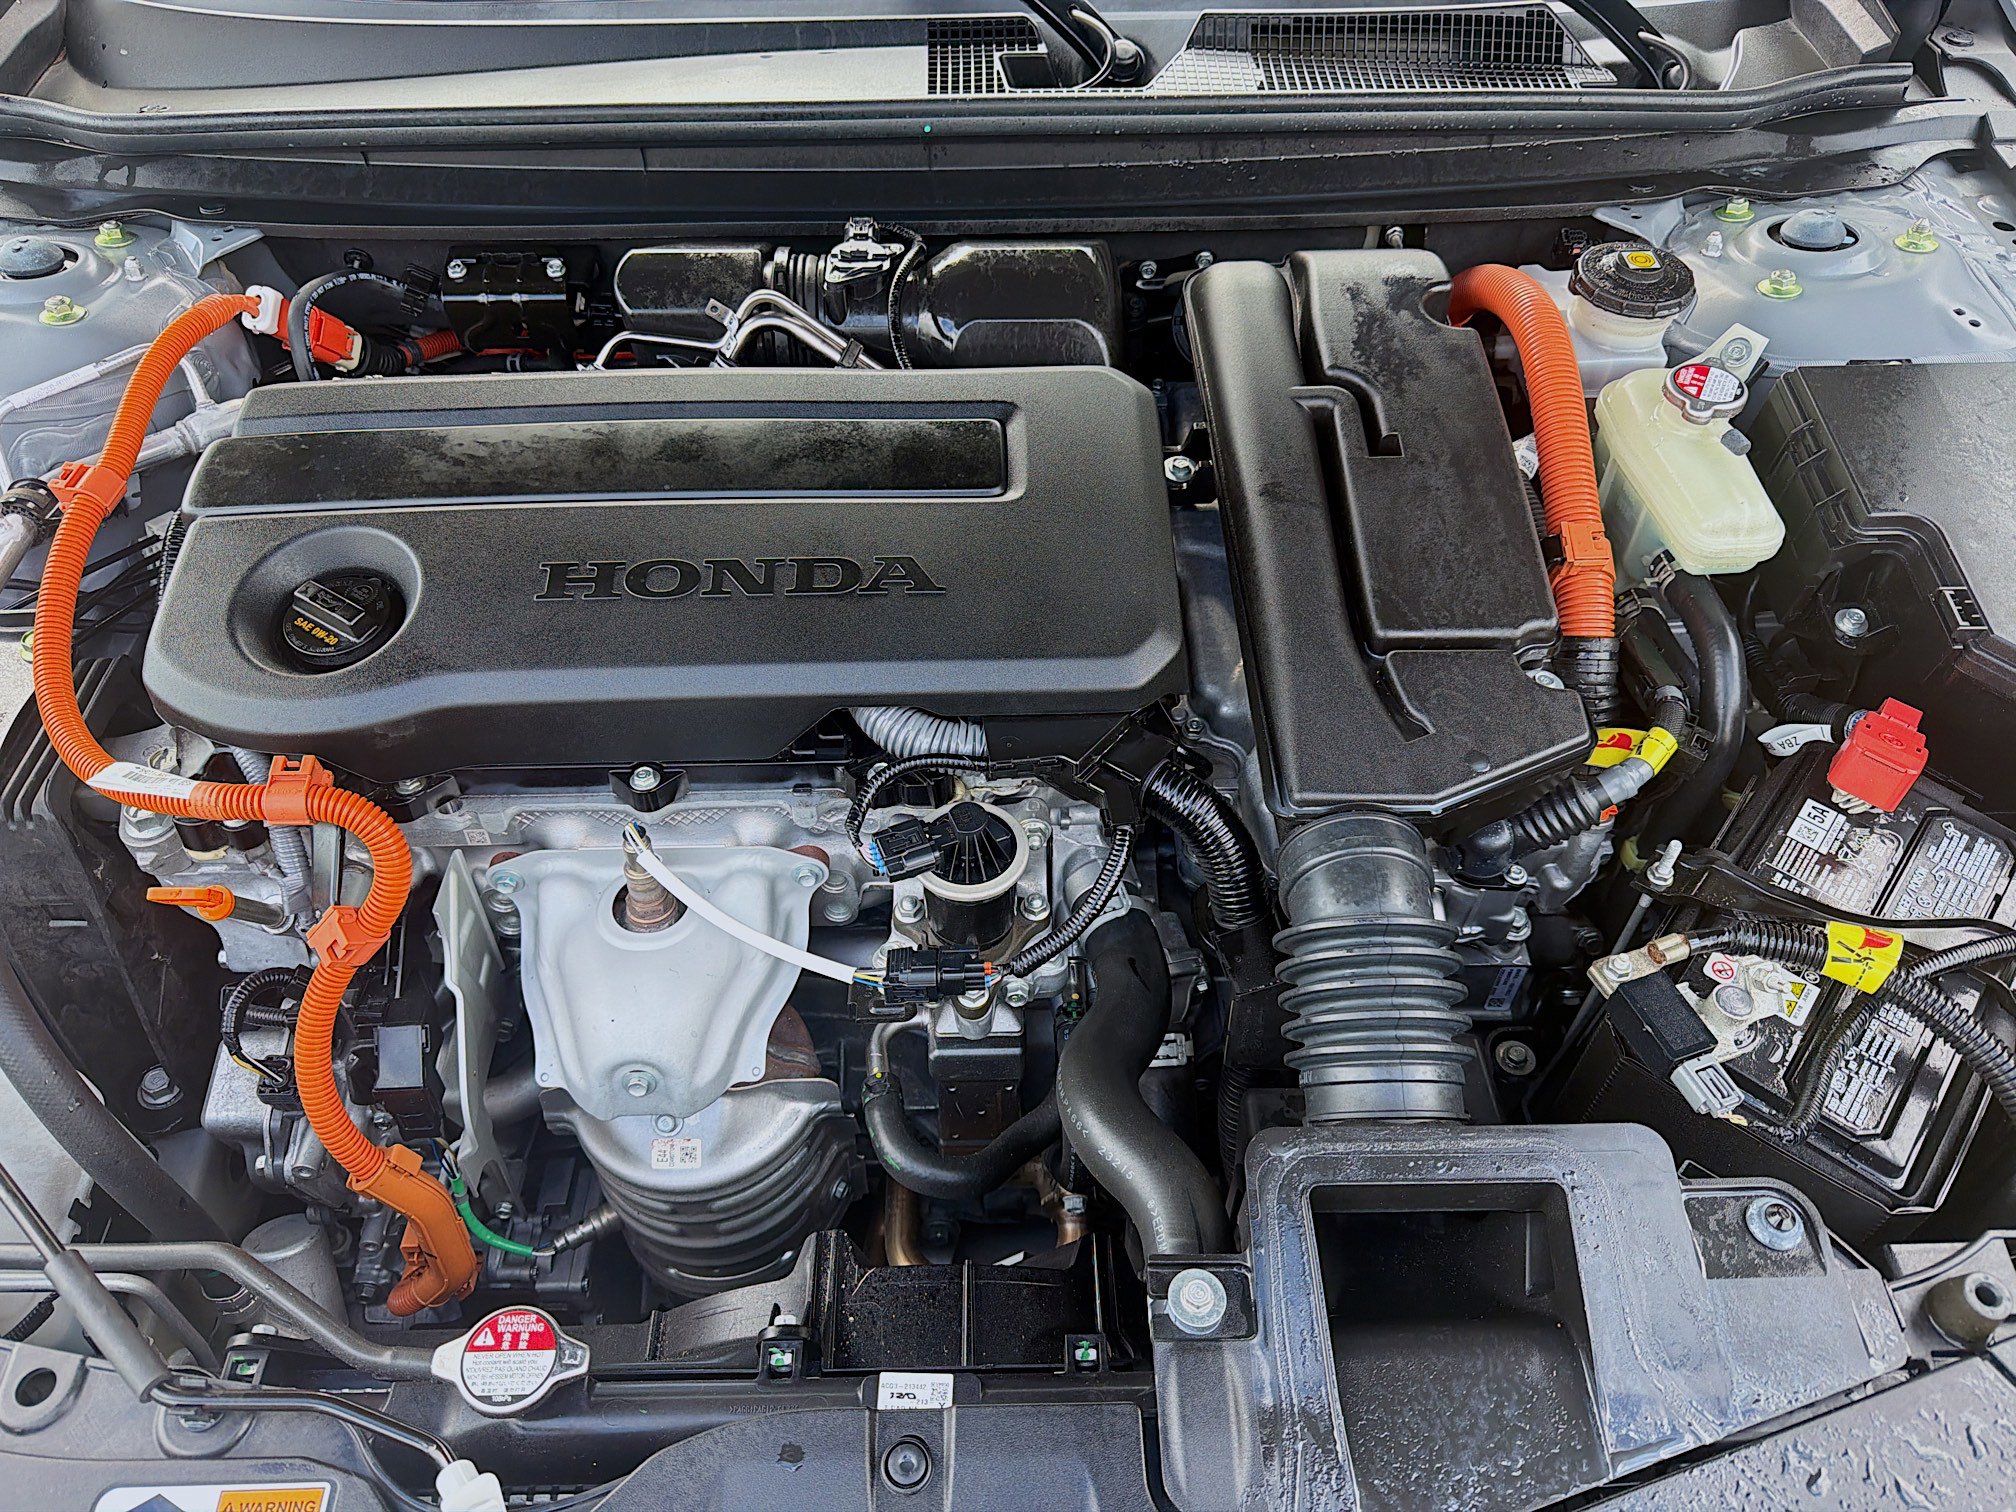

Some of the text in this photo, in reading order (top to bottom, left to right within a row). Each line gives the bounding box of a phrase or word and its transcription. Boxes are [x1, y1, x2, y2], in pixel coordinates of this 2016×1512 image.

[533, 555, 947, 601] HONDA
[294, 617, 339, 646] SAE 0W-20
[1806, 805, 1830, 824] 5A
[1098, 1144, 1135, 1181] 23215
[497, 1323, 544, 1332] WARNUNG
[498, 1314, 537, 1324] DANGER
[235, 1500, 317, 1512] WARNING
